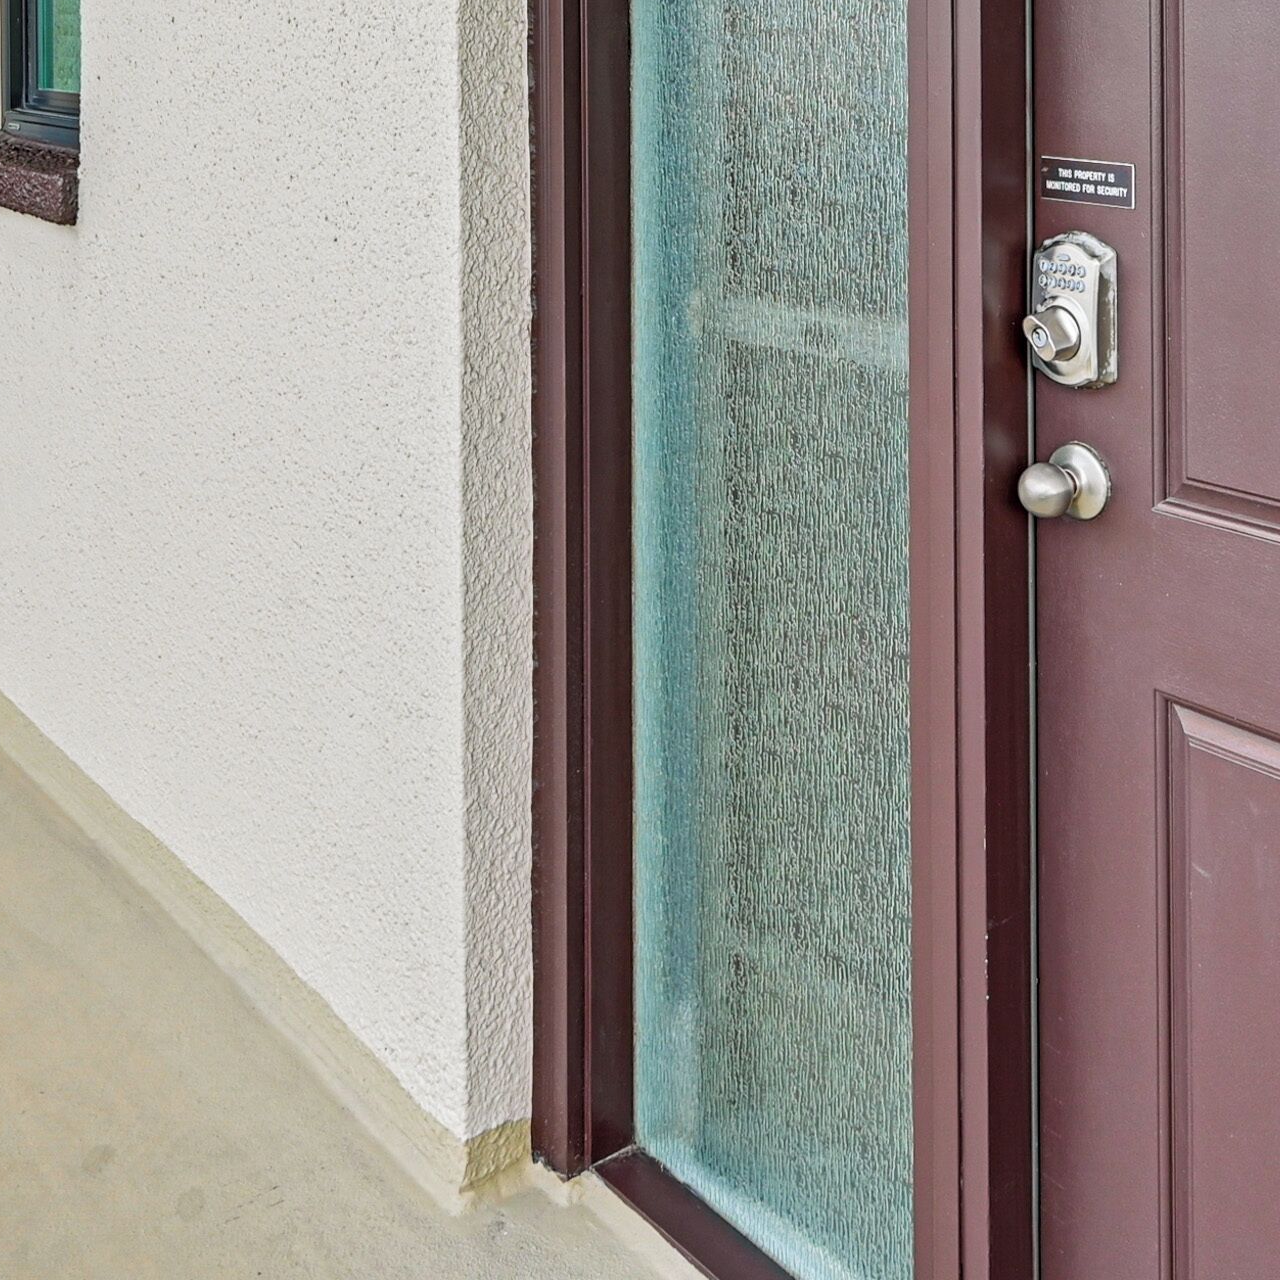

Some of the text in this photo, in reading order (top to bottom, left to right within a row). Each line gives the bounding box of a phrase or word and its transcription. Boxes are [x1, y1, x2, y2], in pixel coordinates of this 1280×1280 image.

[1058, 167, 1115, 183] THIS PROPERTY IS
[1046, 180, 1127, 197] MONITORED FOR SECURITY
